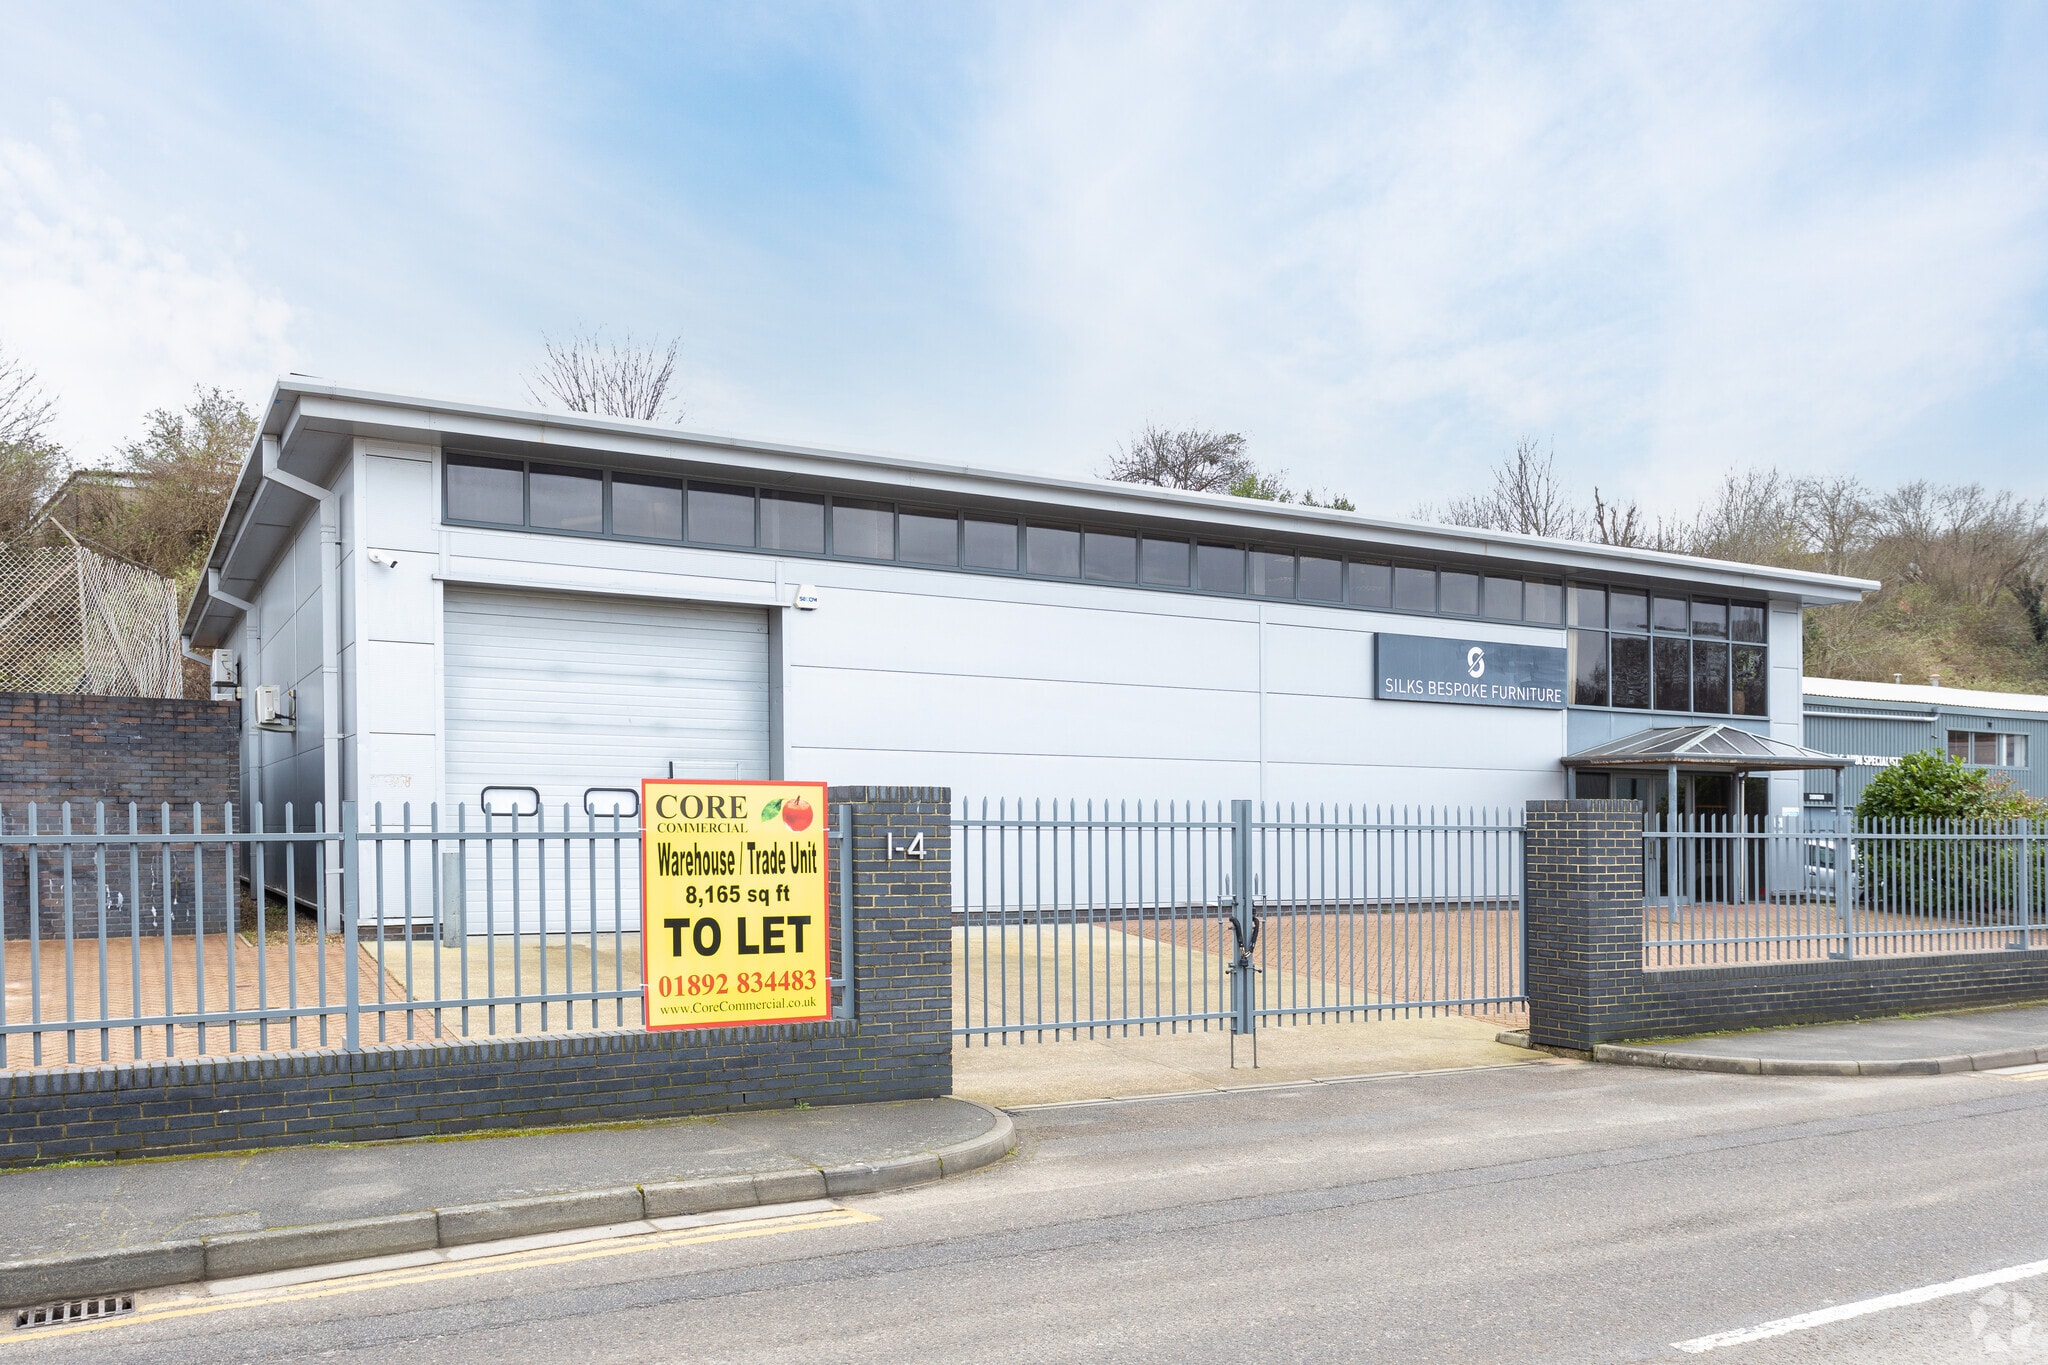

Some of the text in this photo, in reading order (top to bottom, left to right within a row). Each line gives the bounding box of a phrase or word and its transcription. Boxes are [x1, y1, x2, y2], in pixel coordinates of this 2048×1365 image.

[1385, 678, 1562, 703] SILKS BESPOKE FURNITURE
[1863, 755, 1903, 767] SPECIALIST
[655, 794, 748, 819] CORE
[657, 822, 748, 834] COMMERCIAL
[657, 842, 735, 876] Warehouse
[747, 841, 786, 875] Trade
[790, 841, 817, 874] Unit
[685, 884, 790, 908] 8,165 sq ft
[663, 915, 812, 957] TO LET
[658, 969, 817, 997] 01892 834483
[660, 996, 817, 1016] www.CoreCommercial.co.uk
